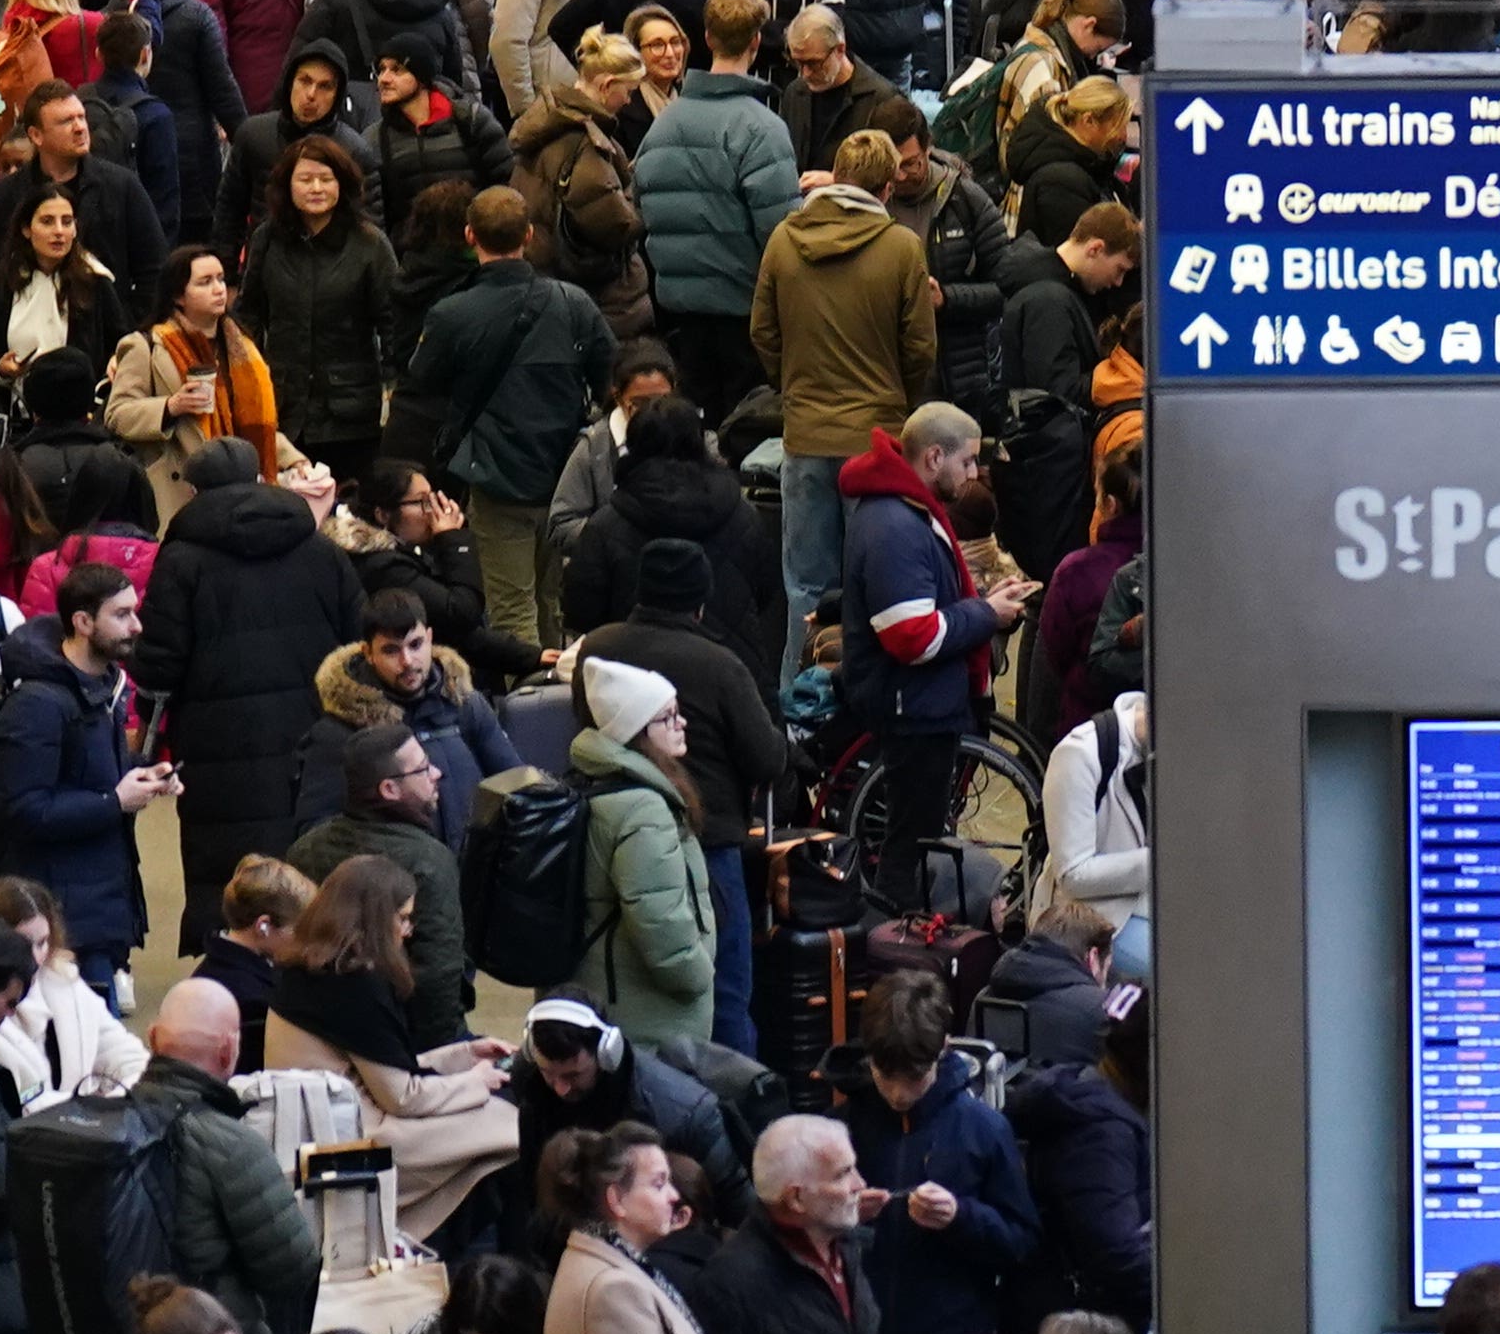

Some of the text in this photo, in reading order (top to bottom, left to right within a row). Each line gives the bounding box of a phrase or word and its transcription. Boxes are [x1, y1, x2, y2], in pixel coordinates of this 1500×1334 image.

[1248, 103, 1455, 146] All trains
[1318, 191, 1430, 213] eurostar
[1283, 248, 1426, 289] Billets
